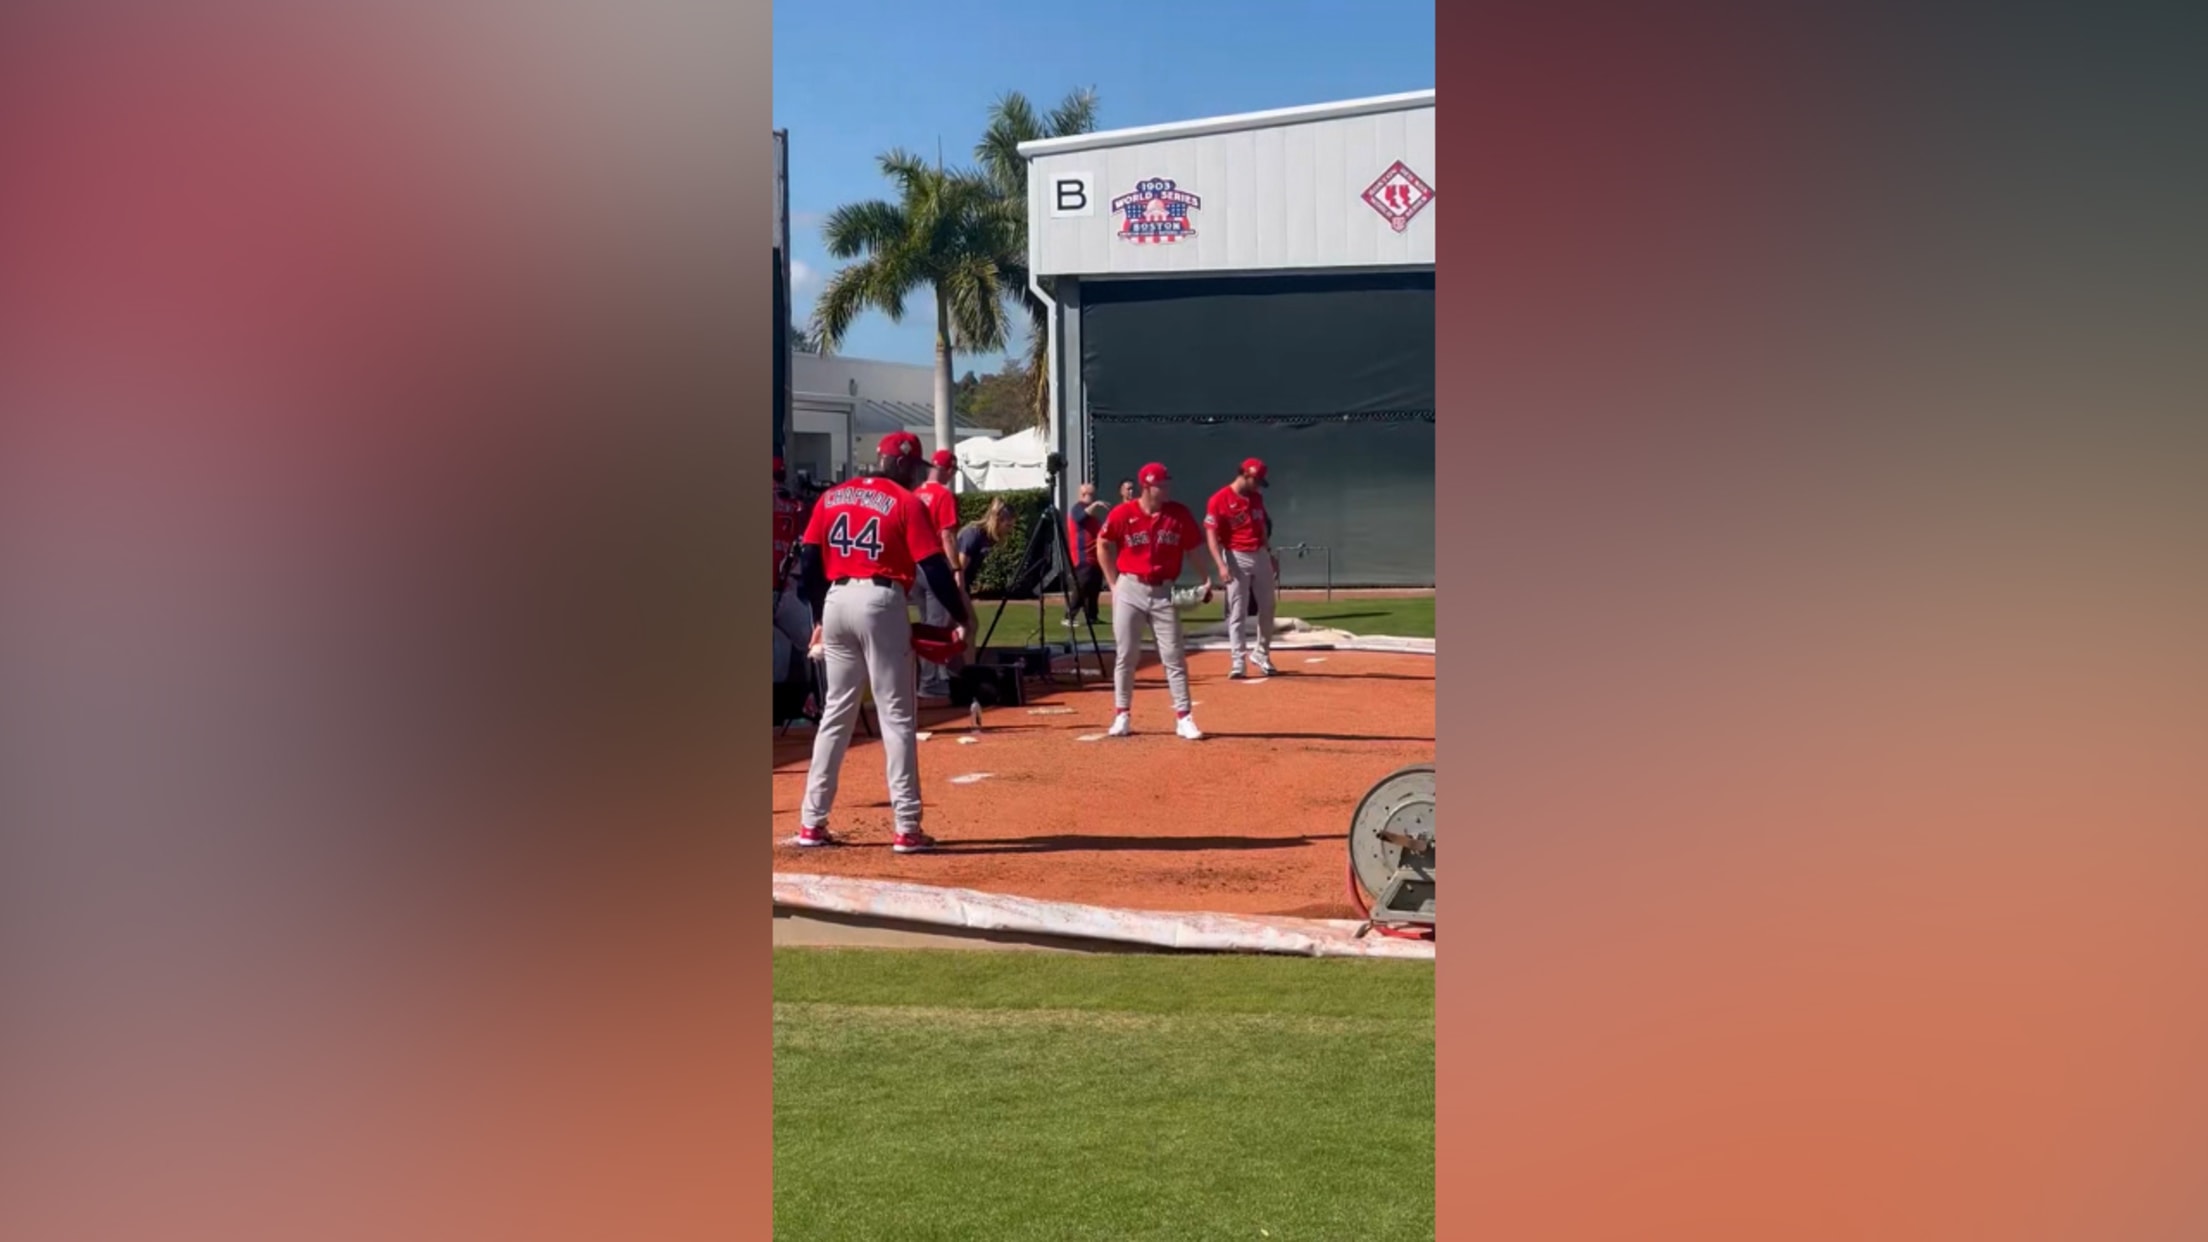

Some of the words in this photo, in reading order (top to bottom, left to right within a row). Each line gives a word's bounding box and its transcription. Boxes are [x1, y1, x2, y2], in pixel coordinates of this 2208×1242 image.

[1057, 179, 1087, 211] B
[1141, 181, 1171, 191] 1903
[1114, 191, 1153, 209] WORLD
[1161, 191, 1198, 206] SERIES
[1133, 222, 1180, 231] BOSTON
[824, 487, 897, 516] CHAPMAN
[828, 512, 884, 561] 44
